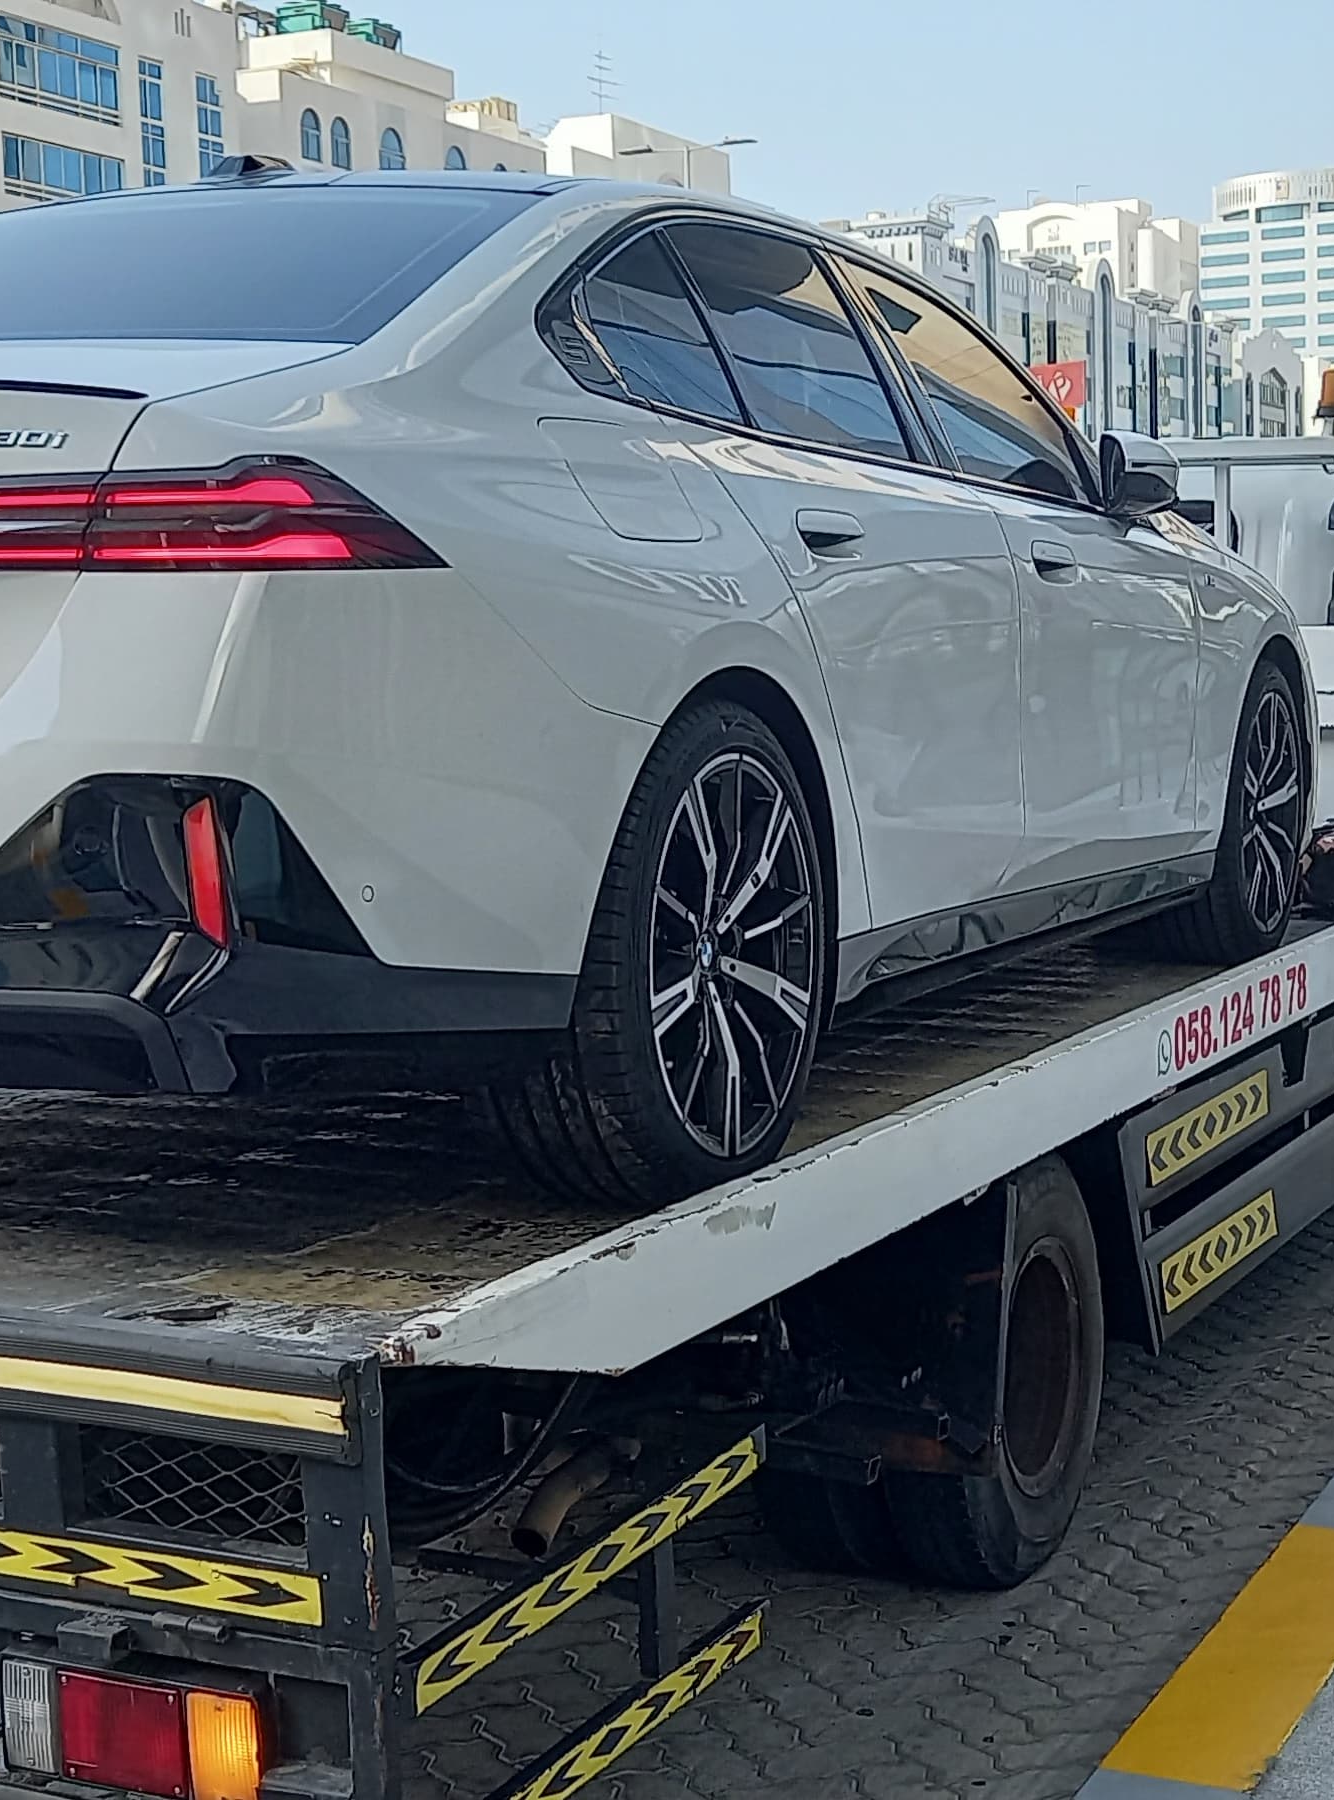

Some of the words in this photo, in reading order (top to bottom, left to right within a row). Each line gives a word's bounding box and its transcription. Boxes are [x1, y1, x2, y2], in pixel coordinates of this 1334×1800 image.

[1175, 985, 1254, 1071] 058.124
[1259, 974, 1281, 1028] 78
[1286, 962, 1307, 1016] 78
